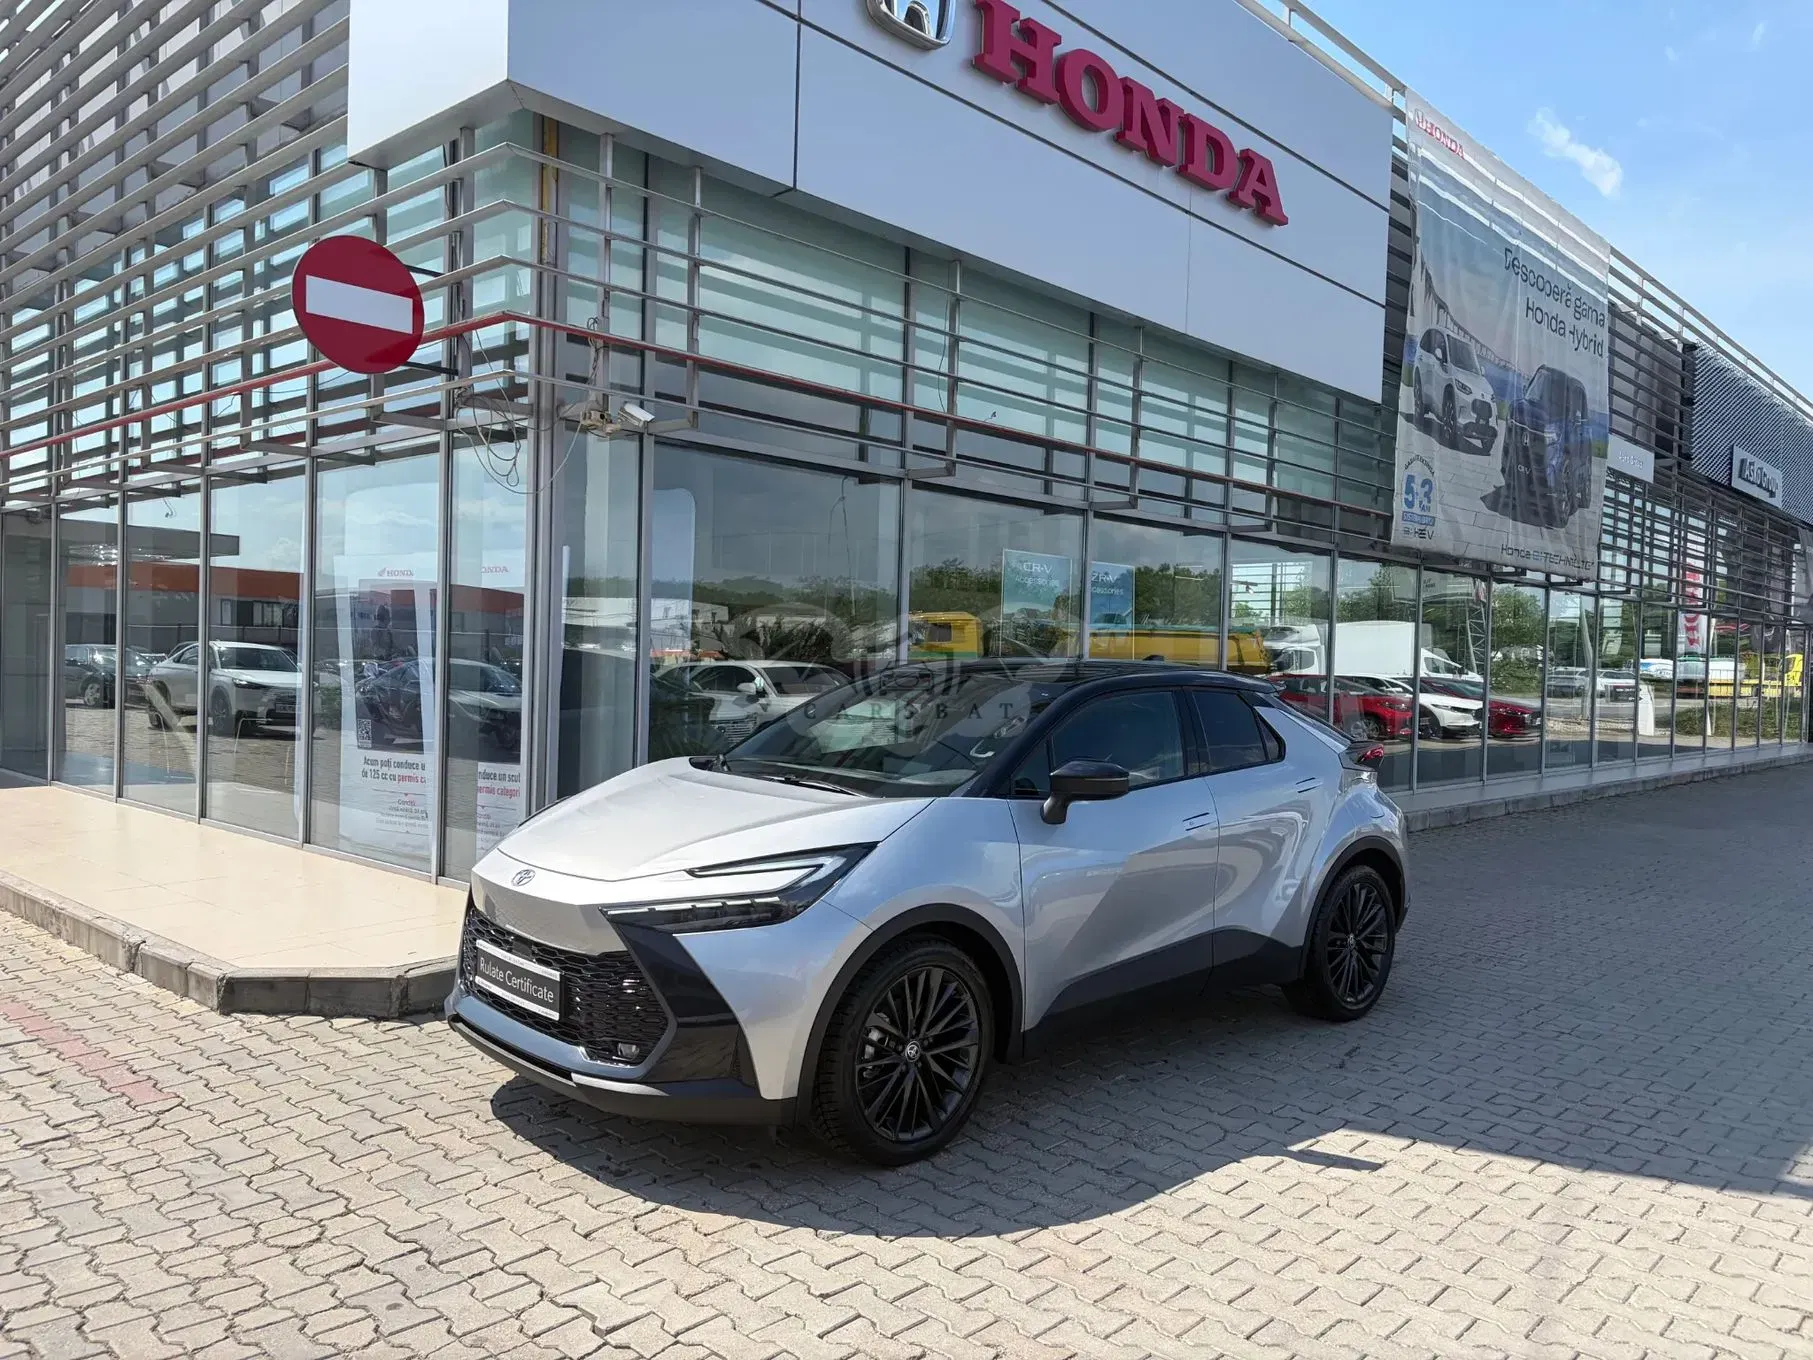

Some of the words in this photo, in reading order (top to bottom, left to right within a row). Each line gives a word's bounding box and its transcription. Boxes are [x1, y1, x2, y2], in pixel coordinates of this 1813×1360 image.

[973, 0, 1289, 227] HONDA
[1424, 119, 1465, 160] HONDA
[1525, 297, 1567, 337] Honda
[1573, 297, 1606, 329] gama
[363, 755, 379, 767] Acum
[393, 758, 420, 771] conduce
[369, 768, 380, 780] 125
[389, 773, 397, 782] cu
[397, 773, 419, 784] permis
[480, 956, 504, 982] Rulate
[505, 970, 554, 1003] Certificate
